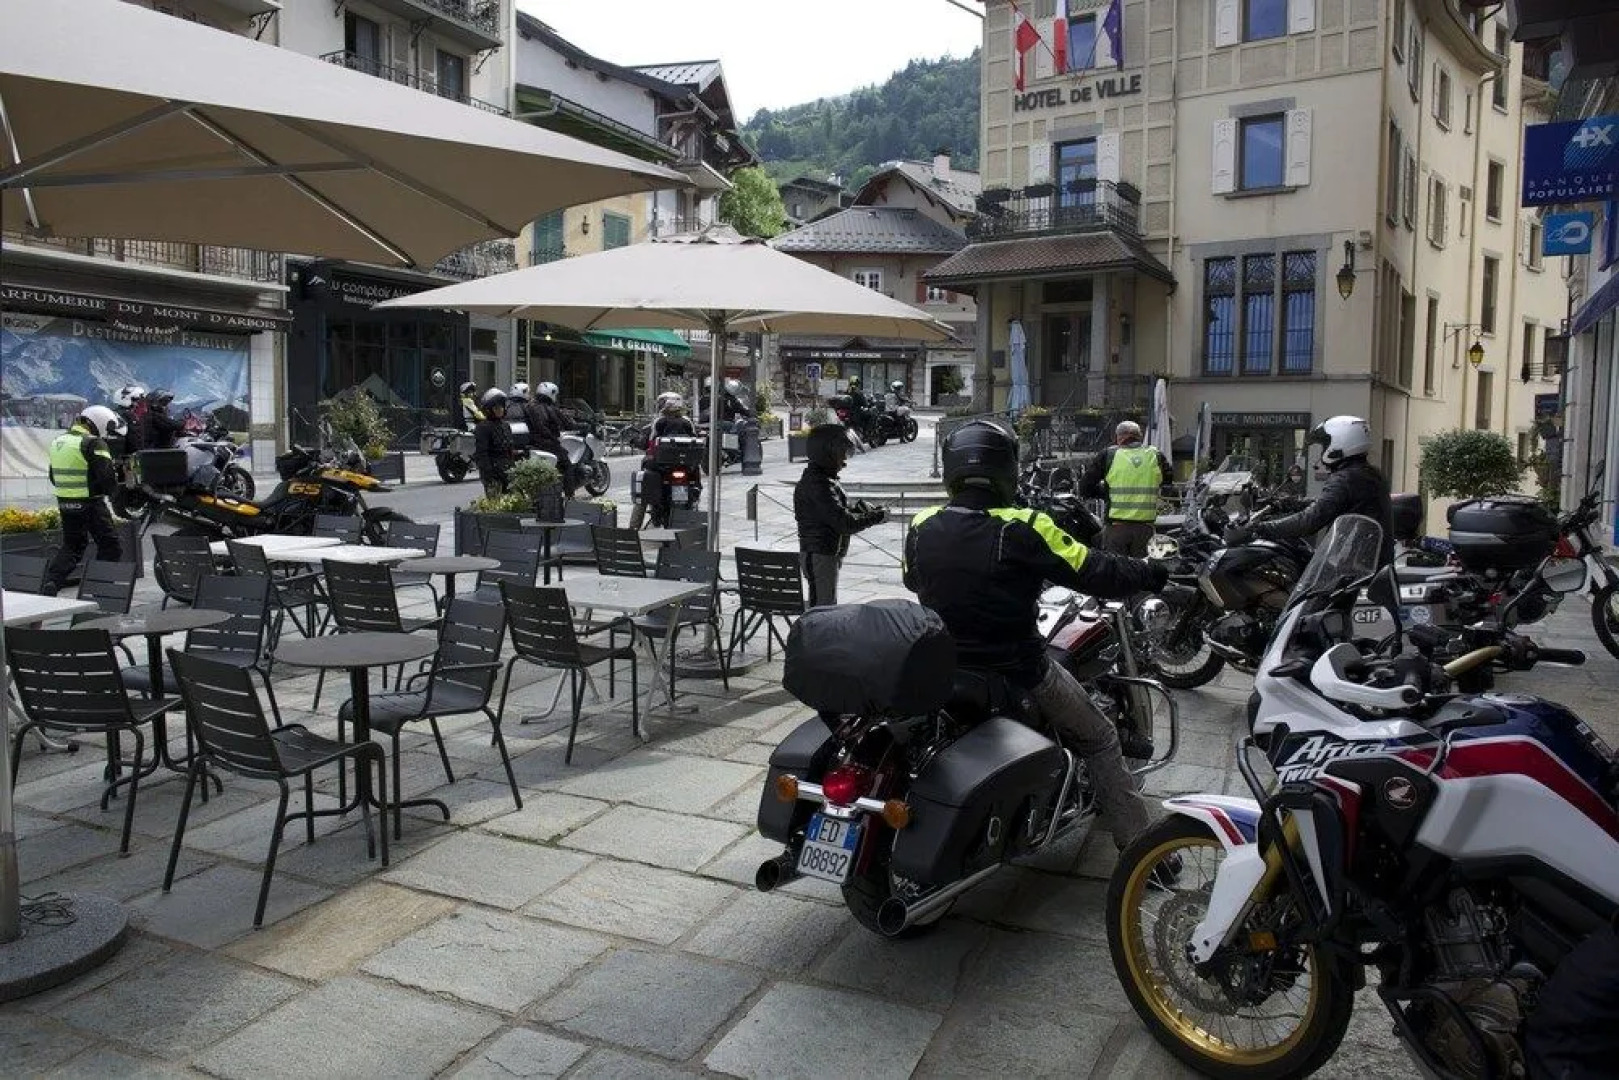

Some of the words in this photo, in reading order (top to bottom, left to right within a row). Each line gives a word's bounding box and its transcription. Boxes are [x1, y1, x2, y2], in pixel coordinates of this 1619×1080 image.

[1015, 88, 1066, 112] HOTEL
[1070, 87, 1092, 104] DE
[1096, 74, 1142, 100] VILLE
[1528, 184, 1616, 199] POPULAIRE
[119, 302, 143, 315] DU
[153, 307, 201, 320] MONT
[210, 313, 277, 329] D'ARBOIS
[611, 338, 626, 350] LA
[1242, 414, 1304, 425] MUNICIPALE
[288, 481, 322, 496] GS
[1284, 736, 1387, 767] Africa
[818, 818, 841, 843] ED
[801, 846, 849, 877] 08892
